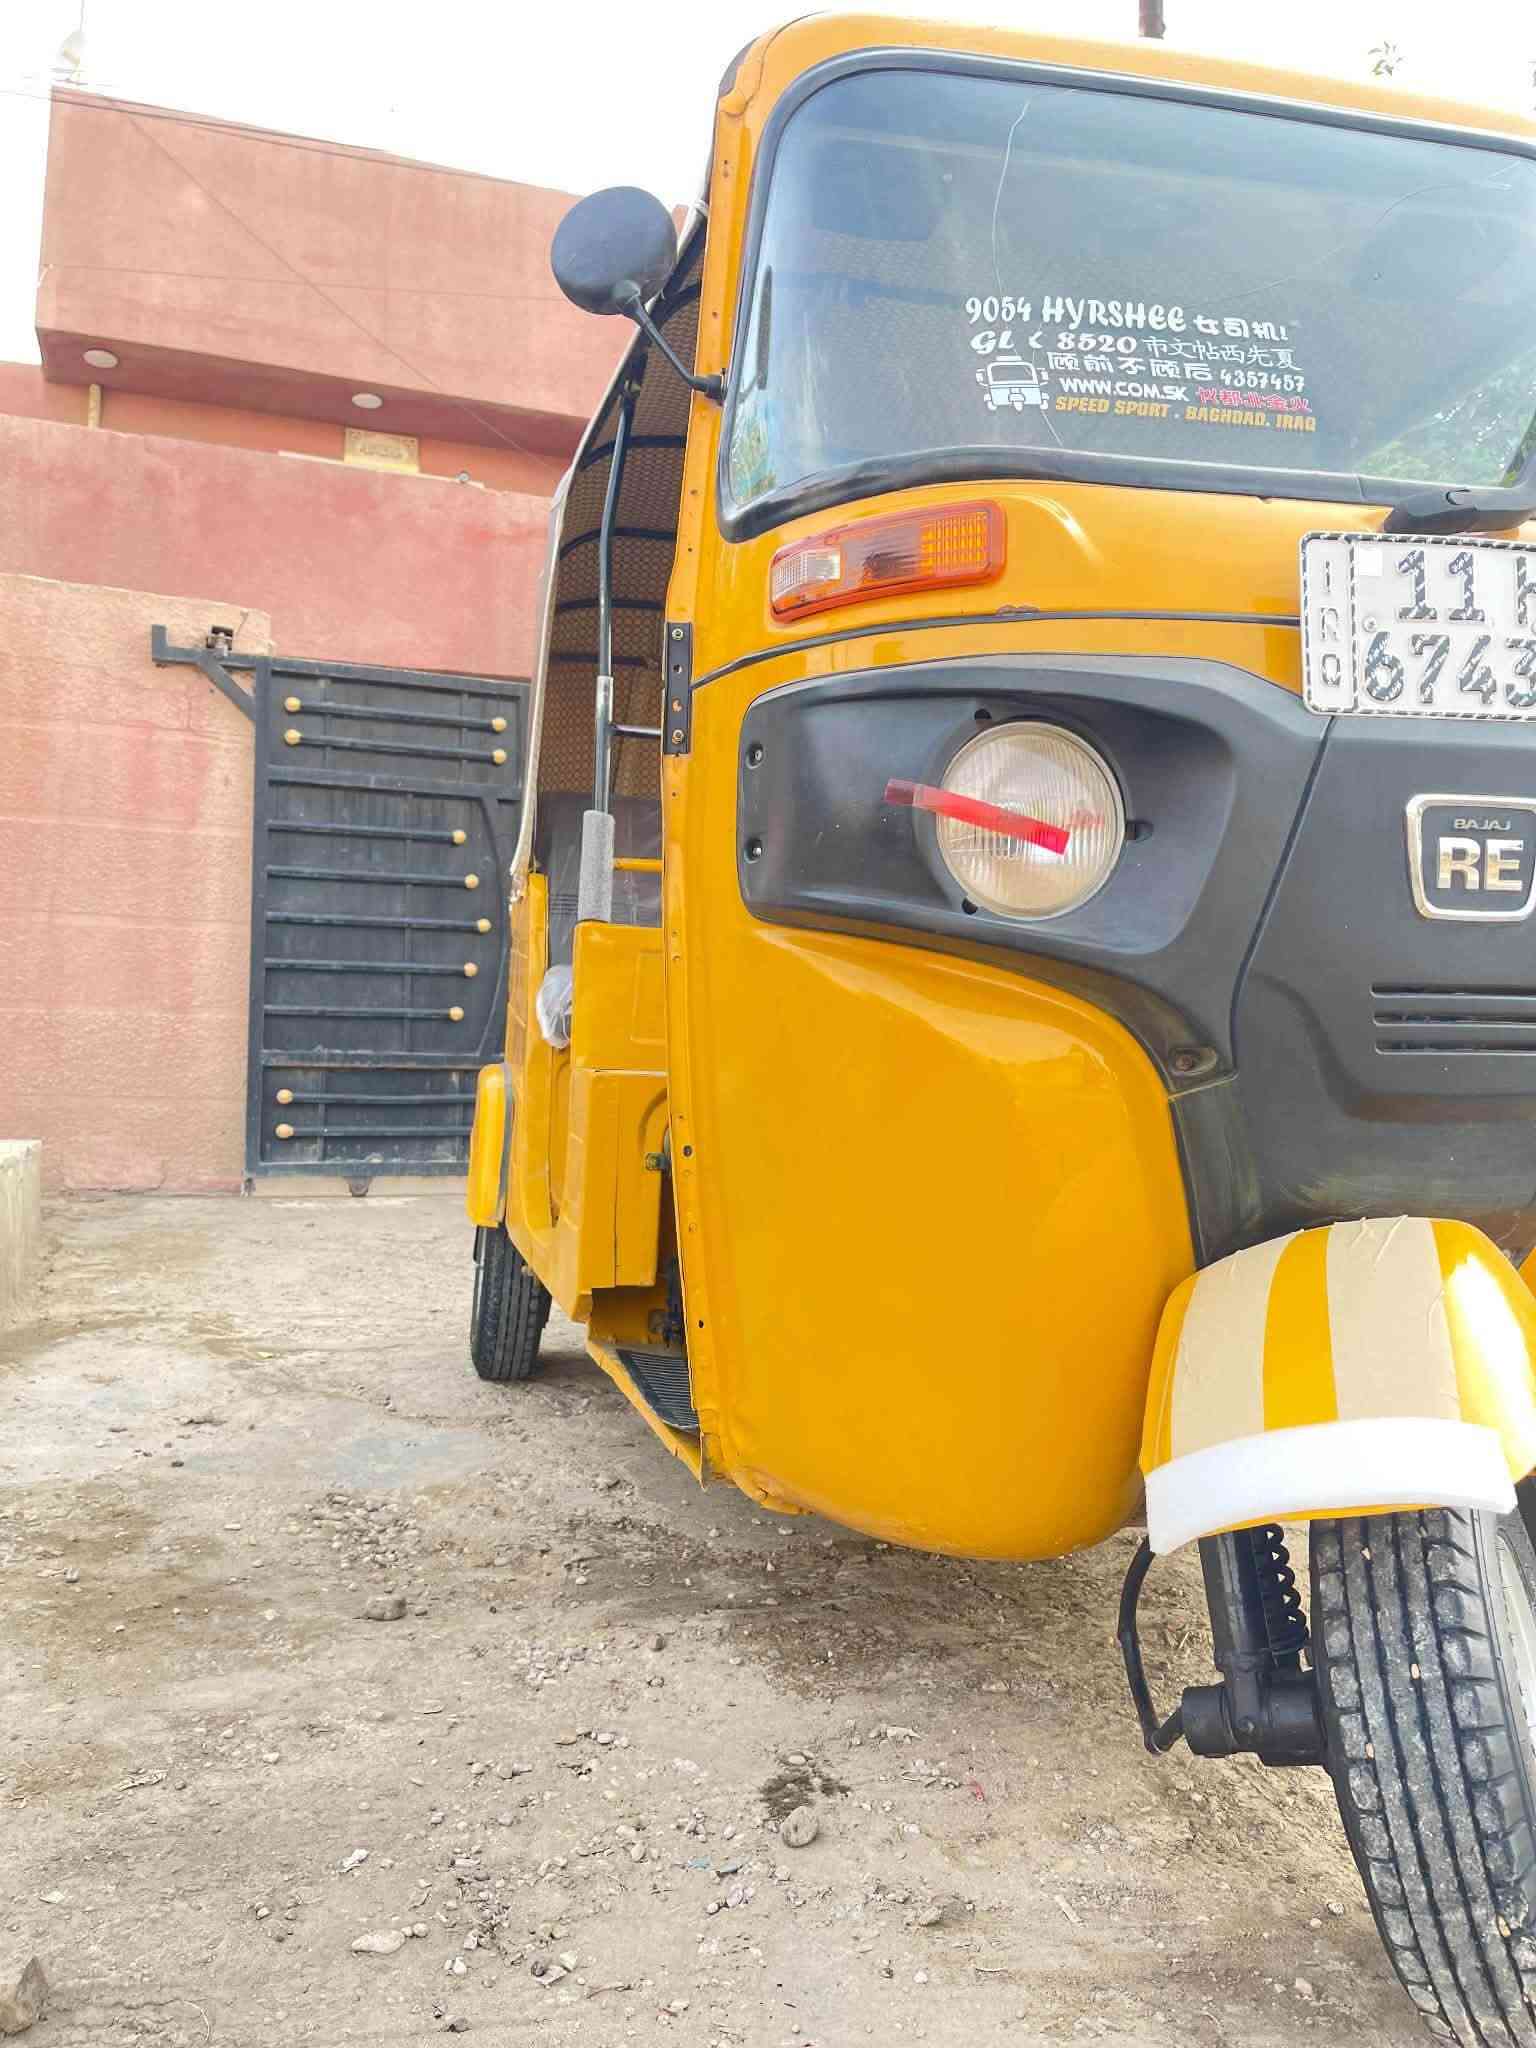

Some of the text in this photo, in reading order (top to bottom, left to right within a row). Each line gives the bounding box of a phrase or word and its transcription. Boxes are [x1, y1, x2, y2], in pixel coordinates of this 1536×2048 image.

[965, 295, 1031, 324] 9054
[1057, 332, 1137, 354] 8520
[1055, 396, 1110, 413] SPEED
[1114, 400, 1169, 418] SPORT
[1275, 414, 1317, 432] IRAQ
[1364, 631, 1536, 708] 6743
[1453, 818, 1512, 831] BAJAJ
[1436, 836, 1524, 891] RE
